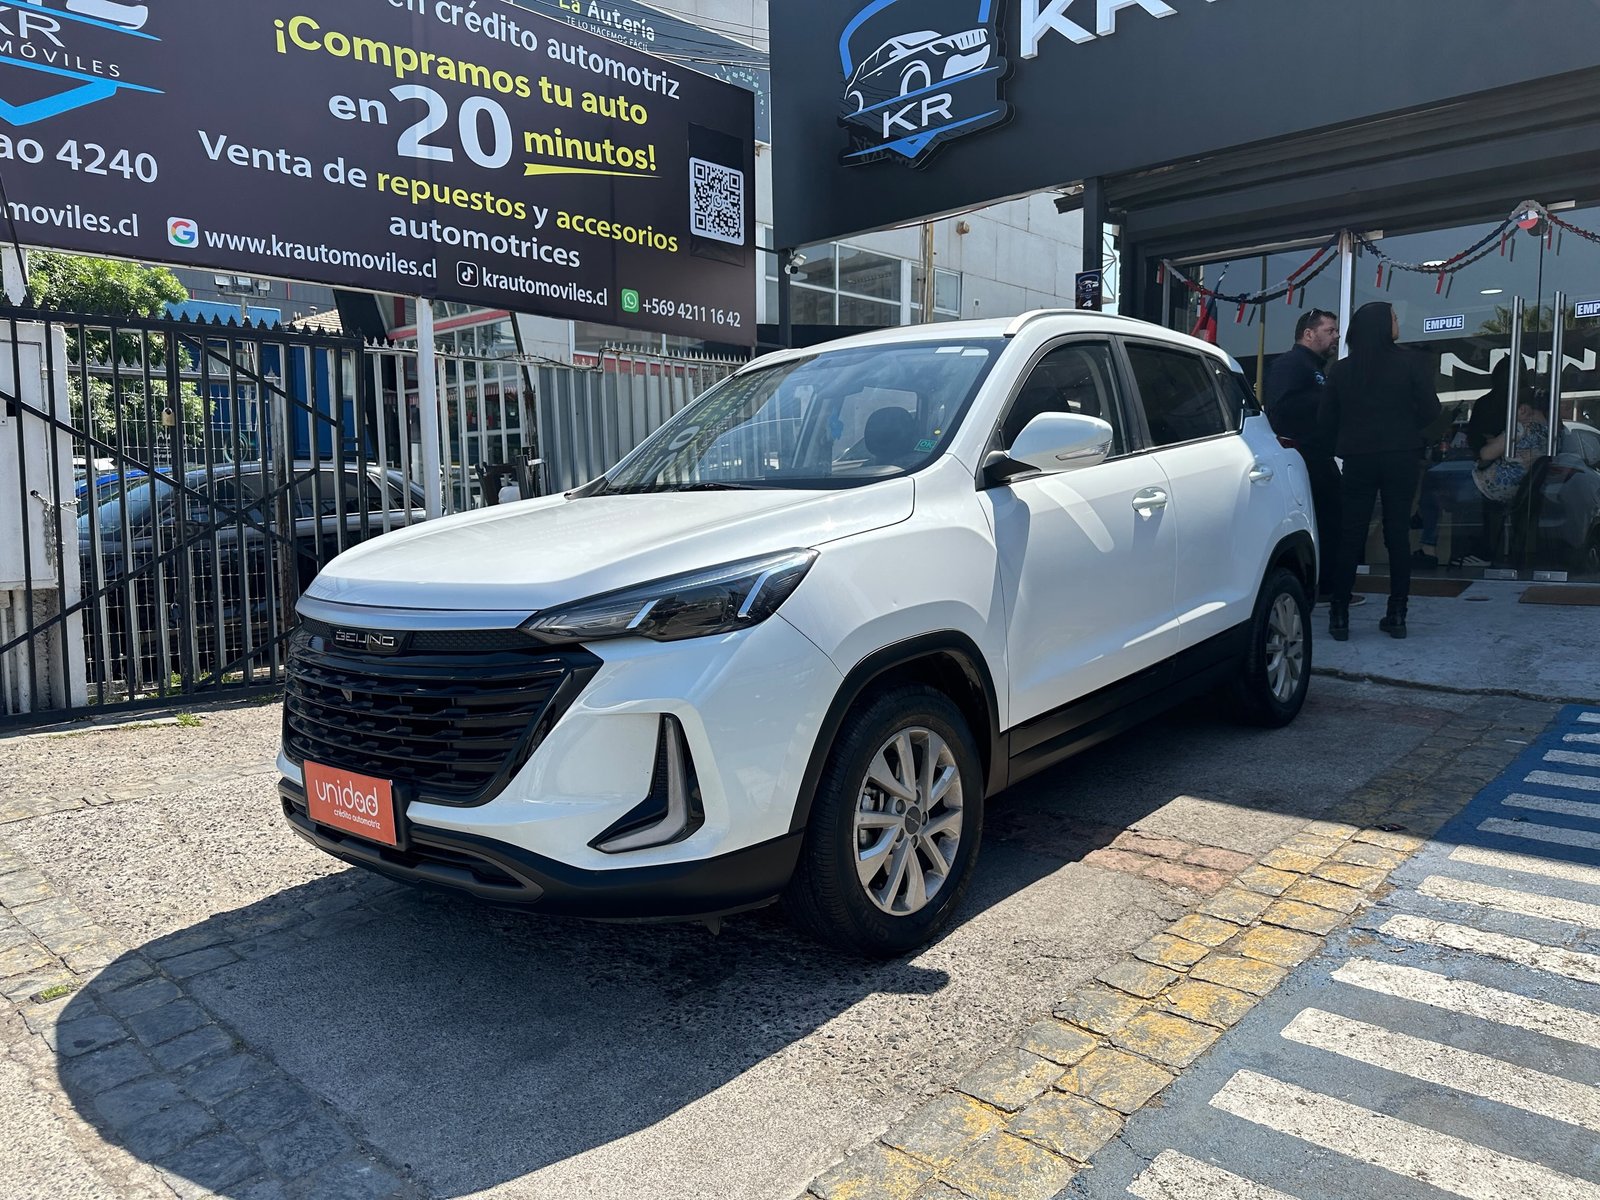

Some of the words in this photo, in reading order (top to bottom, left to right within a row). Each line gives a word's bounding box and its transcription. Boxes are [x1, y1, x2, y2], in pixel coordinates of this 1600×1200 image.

[435, 0, 538, 52] crédito
[547, 38, 681, 100] automotriz
[566, 15, 576, 26] TE
[577, 20, 589, 30] LO
[590, 24, 628, 44] HACEMOS
[538, 76, 574, 109] tu
[582, 92, 648, 125] auto
[883, 92, 953, 139] KR
[328, 95, 388, 125] en
[389, 84, 513, 169] 20
[523, 128, 657, 171] minutos!
[56, 139, 159, 183] 4240
[198, 130, 313, 179] Venta
[323, 157, 368, 189] de
[377, 173, 527, 219] repuestos
[532, 205, 549, 230] y
[557, 212, 679, 252] accesorios
[0, 201, 139, 237] moviles.cl
[204, 230, 438, 279] www.krautomoviles.cl
[389, 216, 581, 268] automotrices
[482, 267, 608, 306] krautomoviles.cl
[642, 298, 675, 316] +569
[677, 303, 706, 322] 4211
[1425, 316, 1463, 331] EMPUJE
[335, 631, 395, 647] BEIJING
[315, 779, 379, 817] unidad
[333, 808, 352, 820] crédito
[351, 814, 381, 830] automotriz
